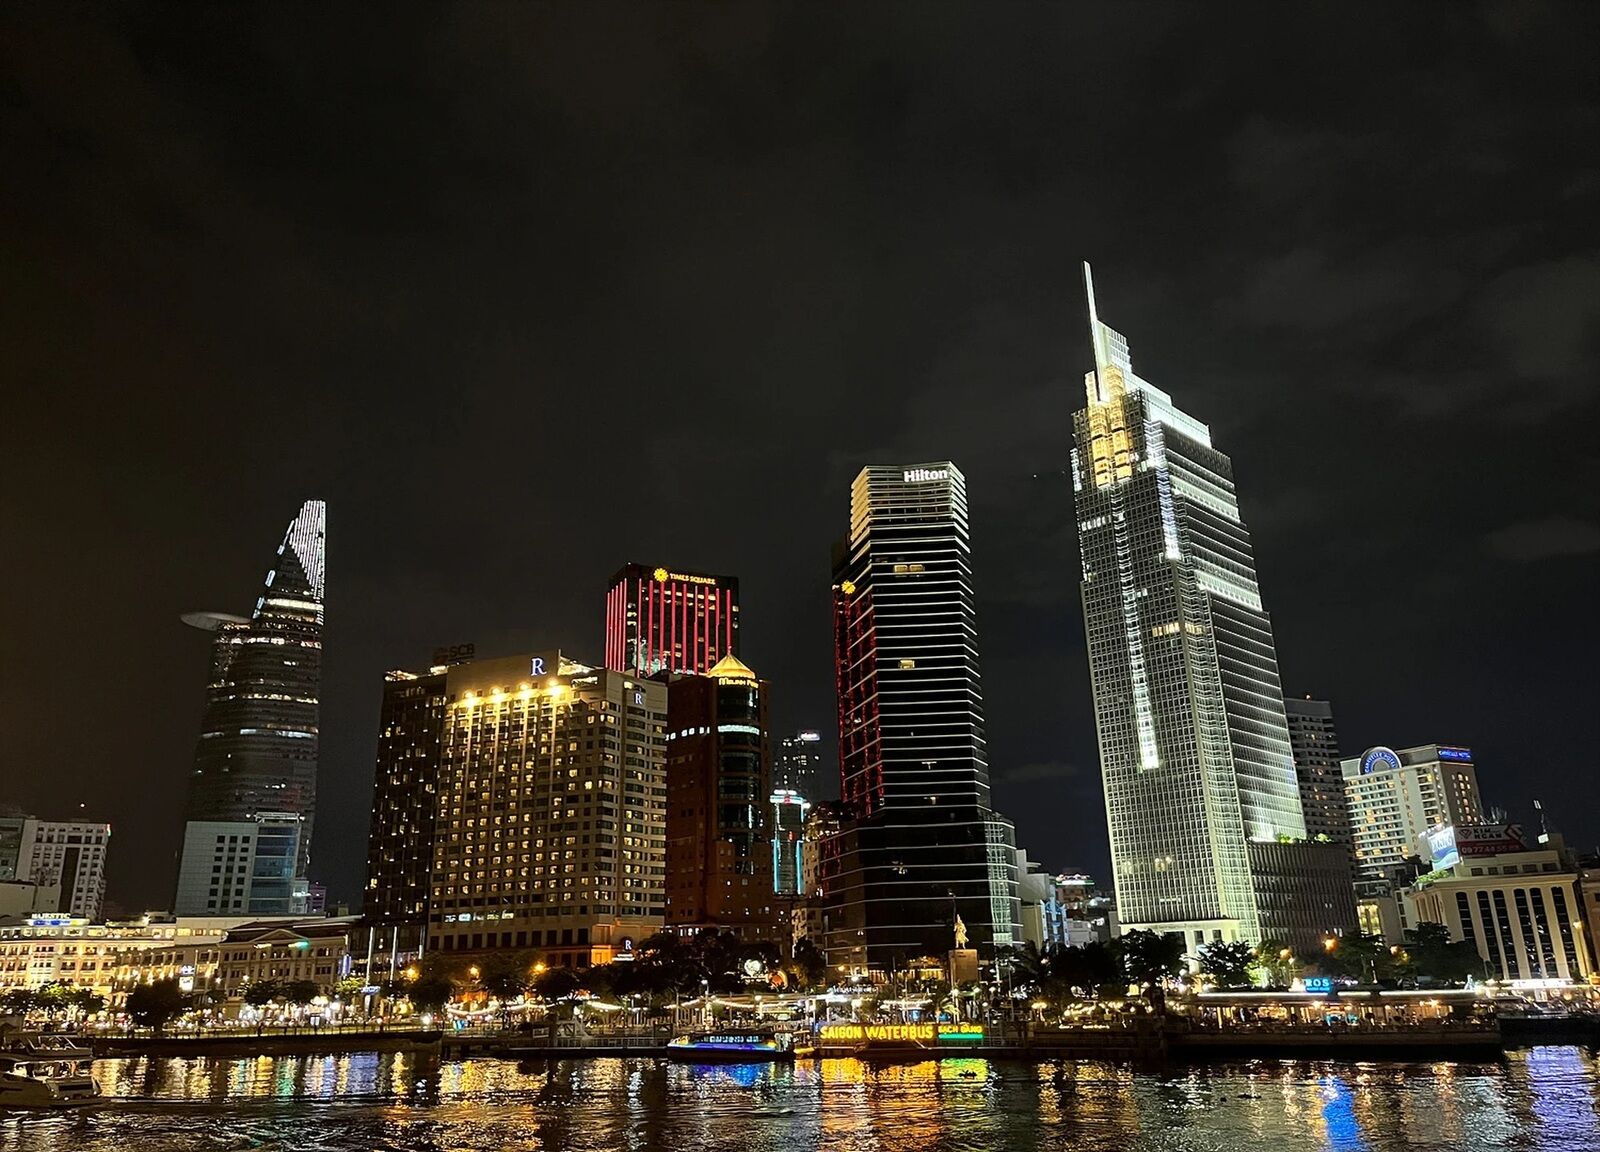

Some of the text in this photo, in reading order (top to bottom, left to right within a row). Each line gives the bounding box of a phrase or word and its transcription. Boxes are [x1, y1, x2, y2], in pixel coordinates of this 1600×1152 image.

[903, 468, 949, 483] Hilton
[690, 576, 716, 585] SQUARE
[449, 643, 475, 658] SCB
[531, 657, 547, 676] R
[634, 693, 643, 705] R
[625, 939, 633, 950] R
[820, 1025, 862, 1039] SAIGON
[864, 1025, 934, 1040] WATERBUS
